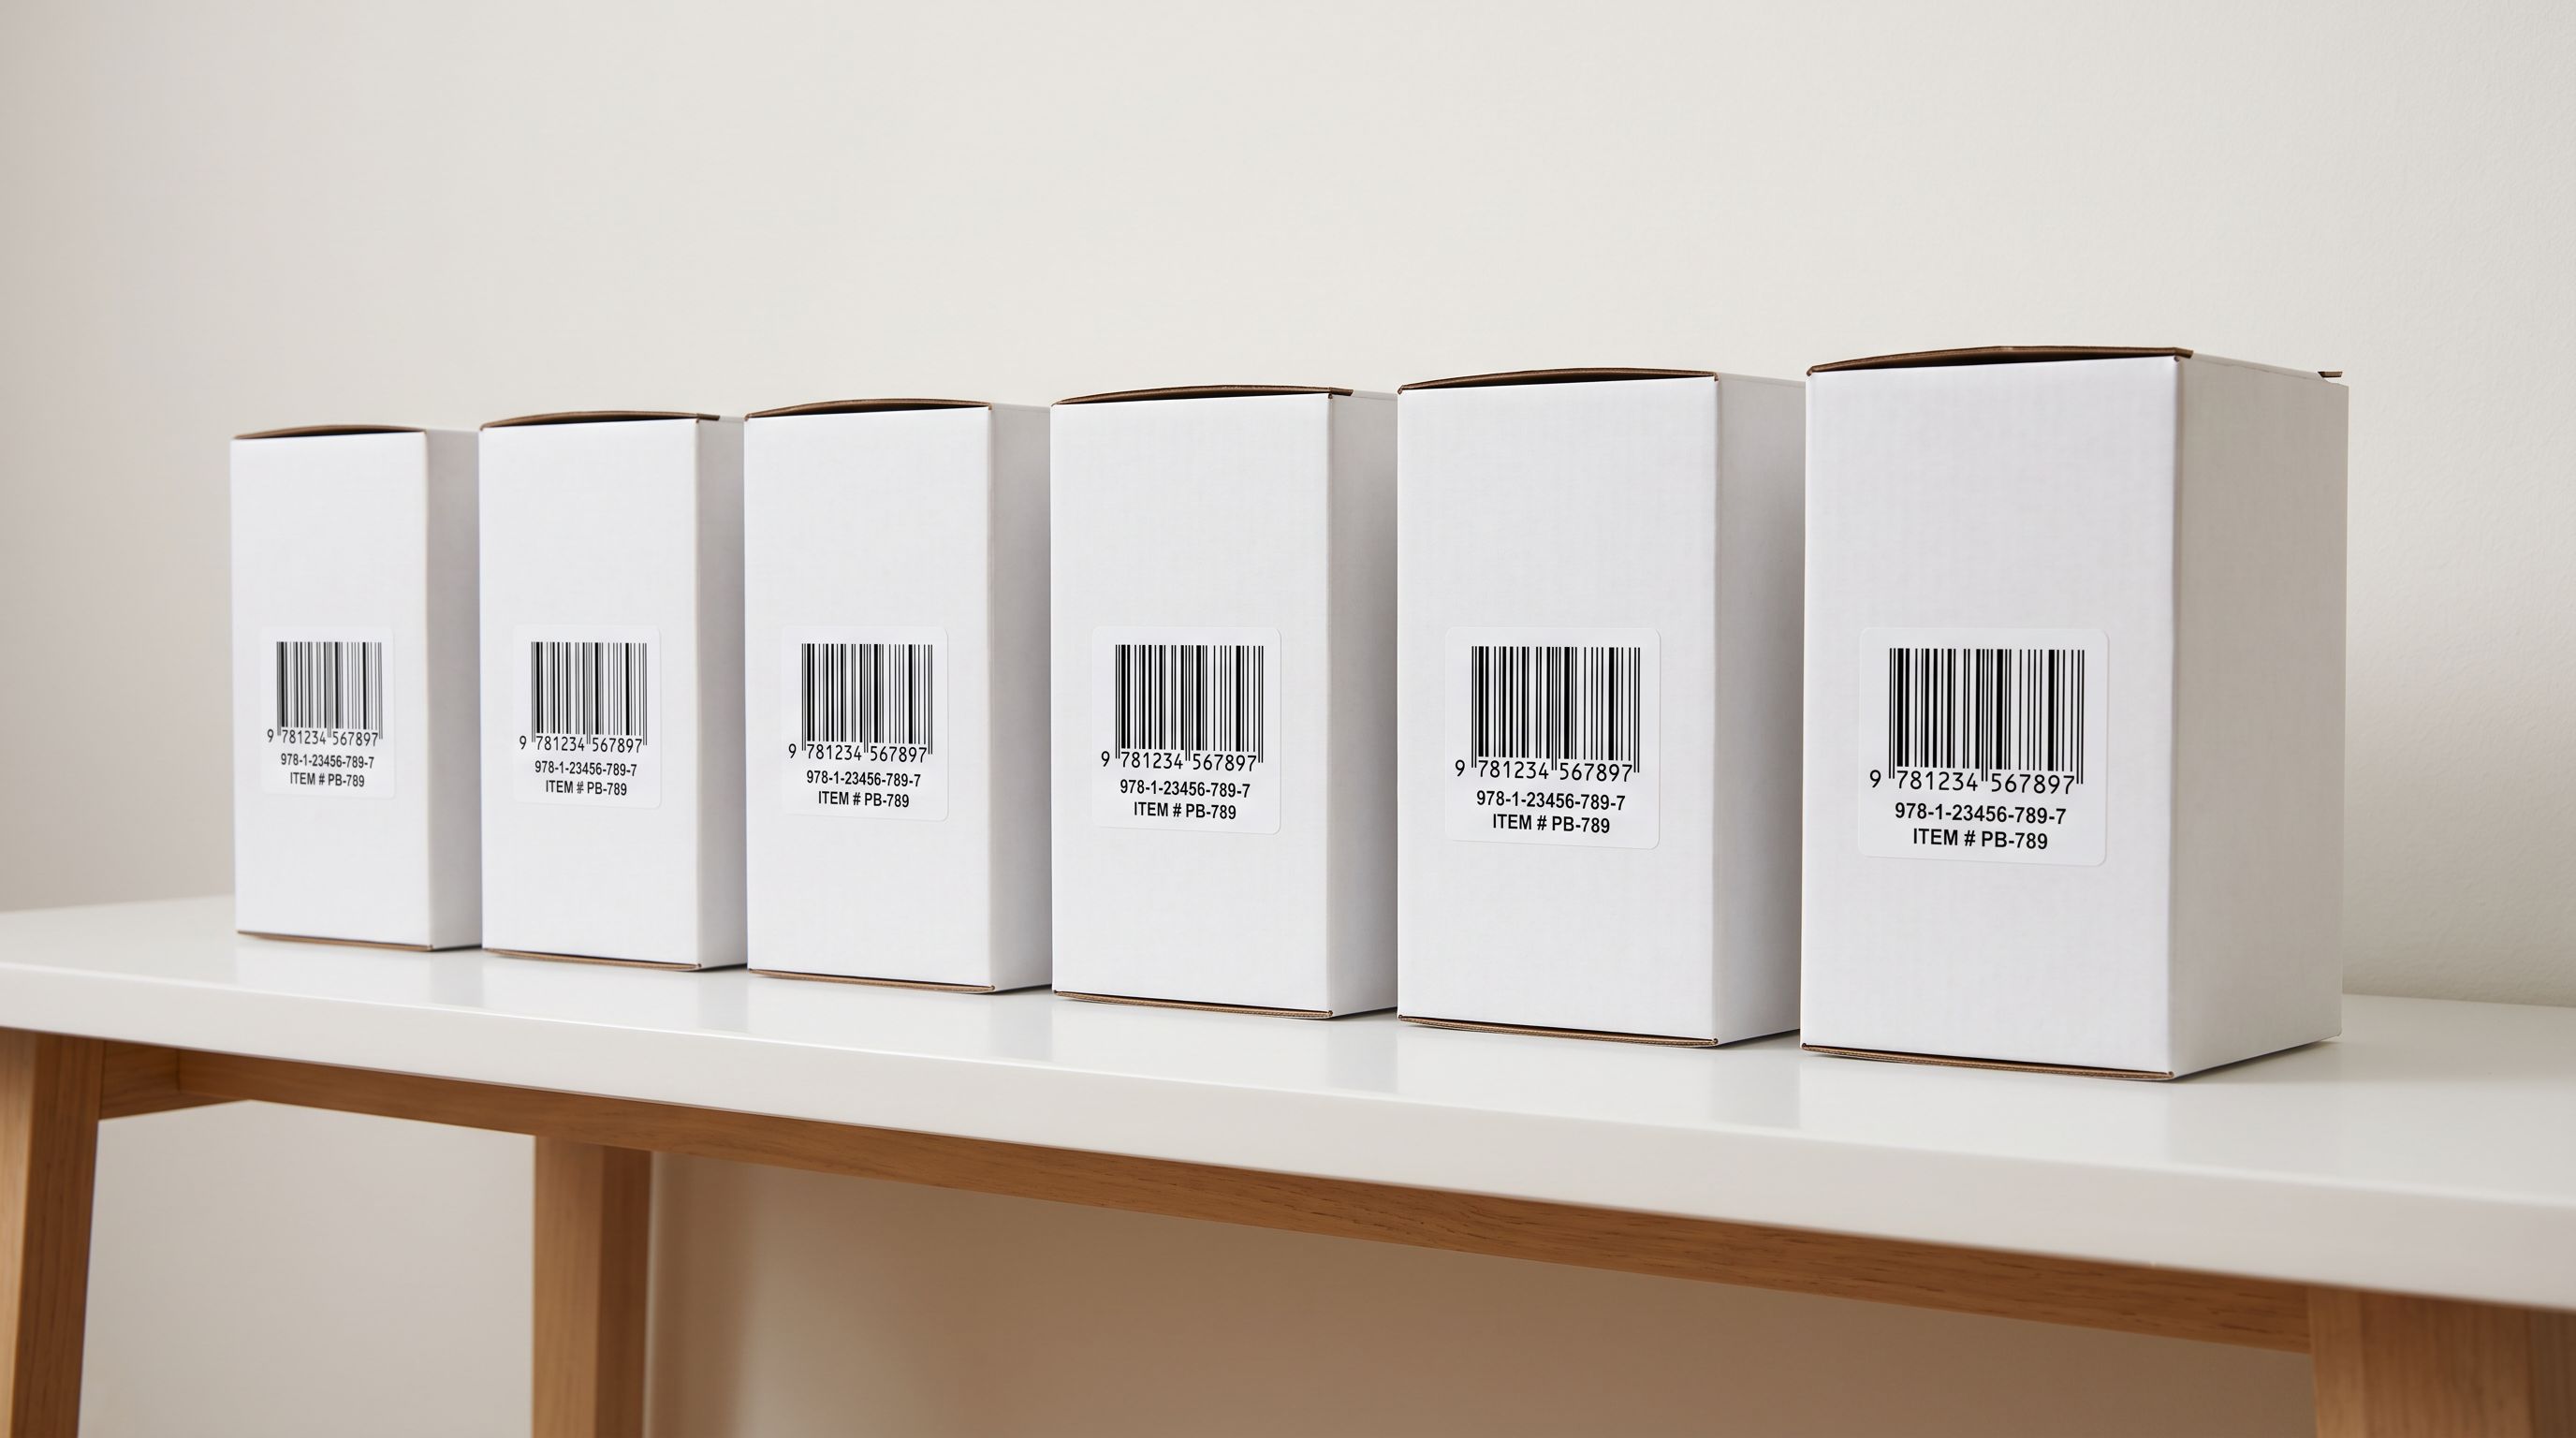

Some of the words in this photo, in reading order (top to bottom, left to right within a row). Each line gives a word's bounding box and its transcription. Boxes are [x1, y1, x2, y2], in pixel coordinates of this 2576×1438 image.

[268, 729, 273, 742] 9
[283, 730, 326, 744] 781234
[333, 731, 378, 746] 567897
[520, 736, 526, 749] 9
[536, 736, 584, 751] 781234
[593, 738, 642, 753] 567897
[281, 754, 374, 769] 978-1-23456-789-7
[788, 743, 796, 758] 9
[807, 744, 862, 760] 781234
[871, 746, 927, 763] 567897
[1102, 751, 1110, 767] 9
[1121, 752, 1183, 769] 781234
[1193, 754, 1256, 771] 567897
[535, 760, 637, 776] 978-1-23456-789-7
[1456, 760, 1465, 776] 9
[1479, 760, 1548, 779] 781234
[1560, 763, 1632, 782] 567897
[290, 772, 315, 785] ITEM
[319, 773, 325, 785] #
[329, 773, 364, 786] PB-789
[807, 770, 921, 786] 978-1-23456-789-7
[1870, 770, 1881, 787] 9
[1897, 770, 1978, 791] 781234
[1991, 773, 2074, 794] 567897
[547, 780, 573, 793] ITEM
[577, 781, 583, 794] #
[588, 782, 626, 796] PB-789
[1120, 779, 1251, 798] 978-1-23456-789-7
[819, 791, 849, 805] ITEM
[853, 792, 861, 805] #
[865, 793, 909, 807] PB-789
[1477, 790, 1625, 810] 978-1-23456-789-7
[1134, 801, 1168, 816] ITEM
[1173, 803, 1181, 816] #
[1186, 803, 1236, 819] PB-789
[1895, 802, 2066, 824] 978-1-23456-789-7
[1494, 814, 1531, 829] ITEM
[1537, 815, 1546, 830] #
[1553, 816, 1610, 833] PB-789
[1914, 829, 1957, 845] ITEM
[1965, 830, 1975, 846] #
[1983, 831, 2048, 849] PB-789
